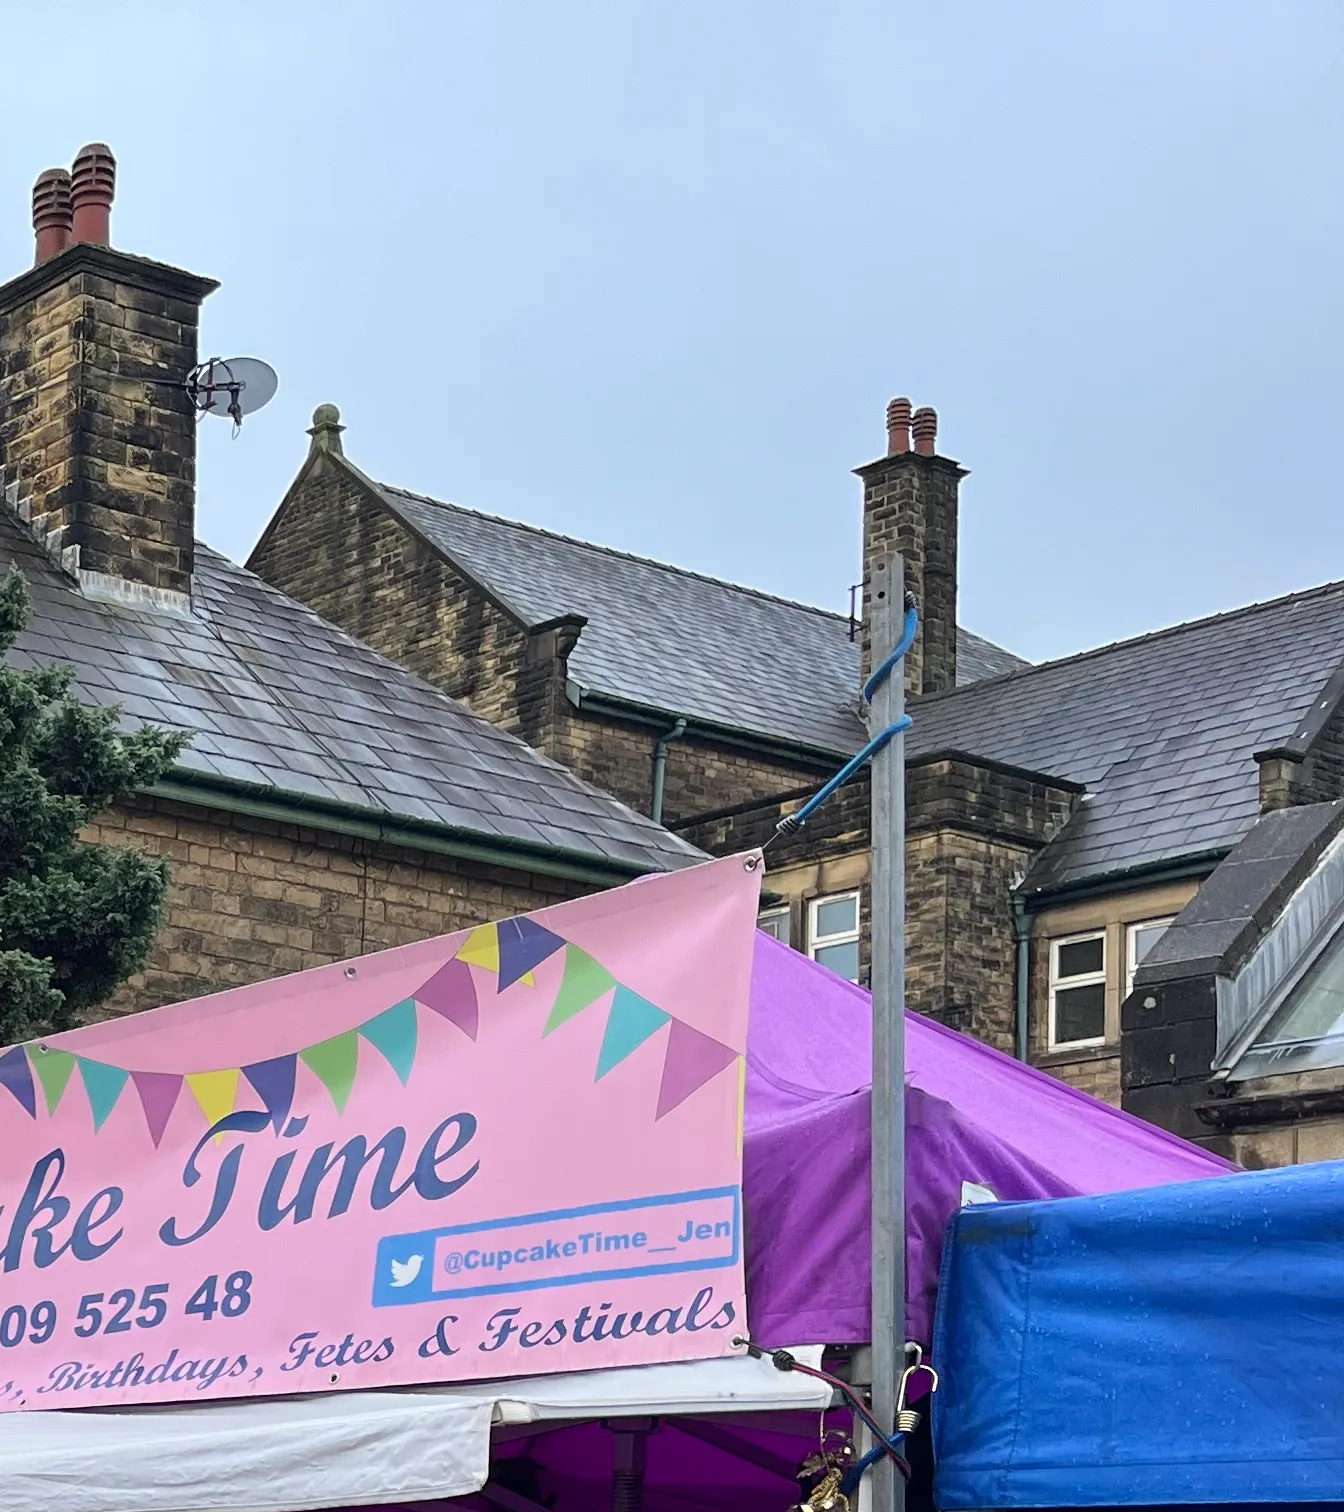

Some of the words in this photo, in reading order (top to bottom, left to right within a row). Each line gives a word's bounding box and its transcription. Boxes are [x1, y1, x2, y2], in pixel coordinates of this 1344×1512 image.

[159, 1110, 480, 1246] Time
[37, 1349, 263, 1394] Birthdays,
[279, 1331, 395, 1372] Fetes
[418, 1315, 460, 1359] &
[479, 1287, 737, 1351] Festivals
[74, 1282, 170, 1338] 525
[185, 1270, 253, 1321] 48
